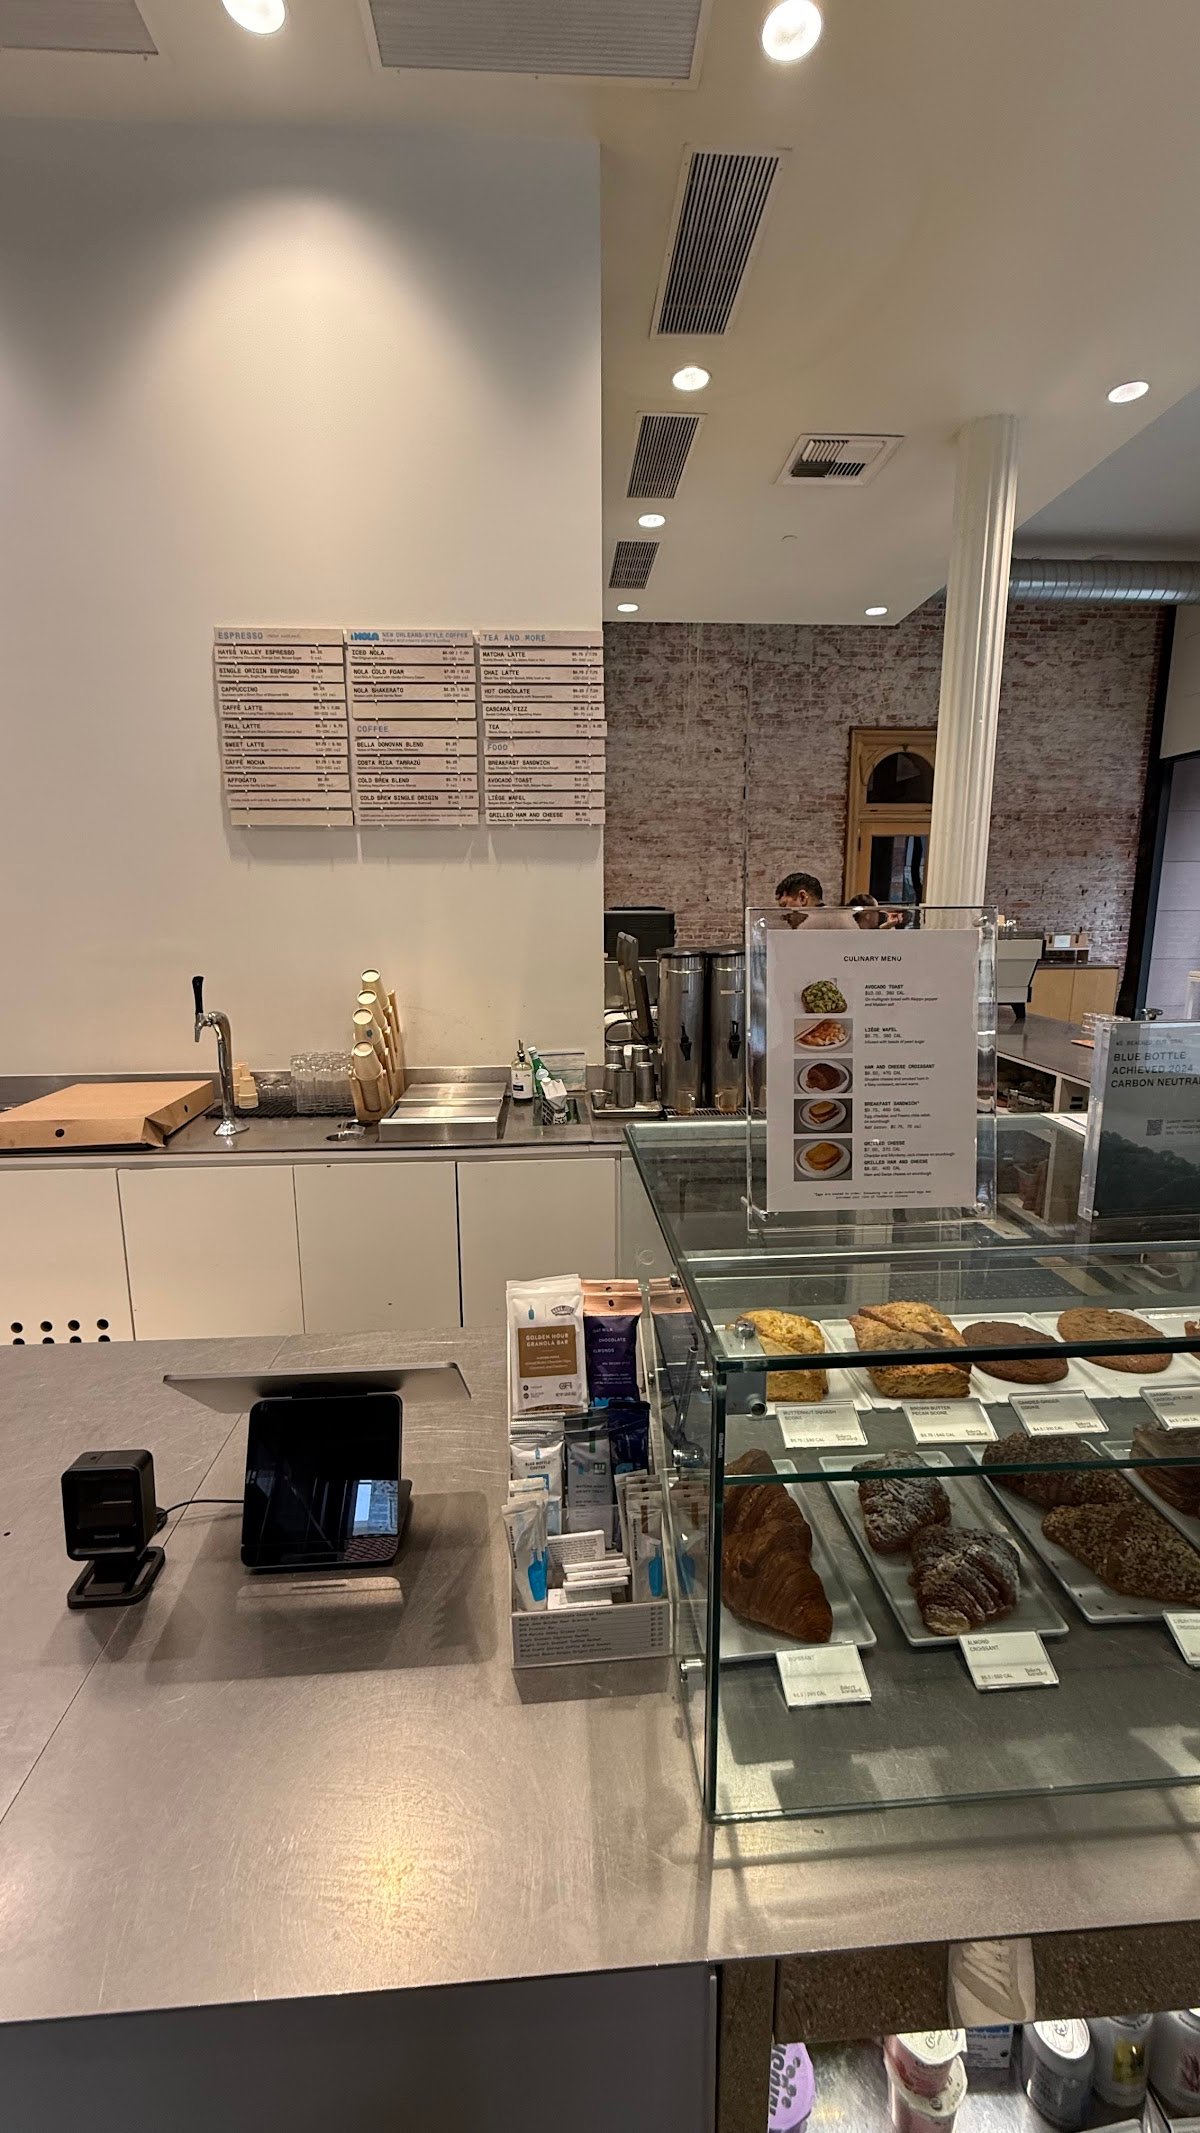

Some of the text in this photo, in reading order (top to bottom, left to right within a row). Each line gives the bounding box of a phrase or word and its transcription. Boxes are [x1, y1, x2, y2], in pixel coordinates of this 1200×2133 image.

[218, 632, 263, 640] ESPRESSO
[1114, 1052, 1186, 1061] BLUE BOTTLE
[1112, 1064, 1193, 1074] ACHIEVED 2024
[1111, 1079, 1154, 1088] CARBON
